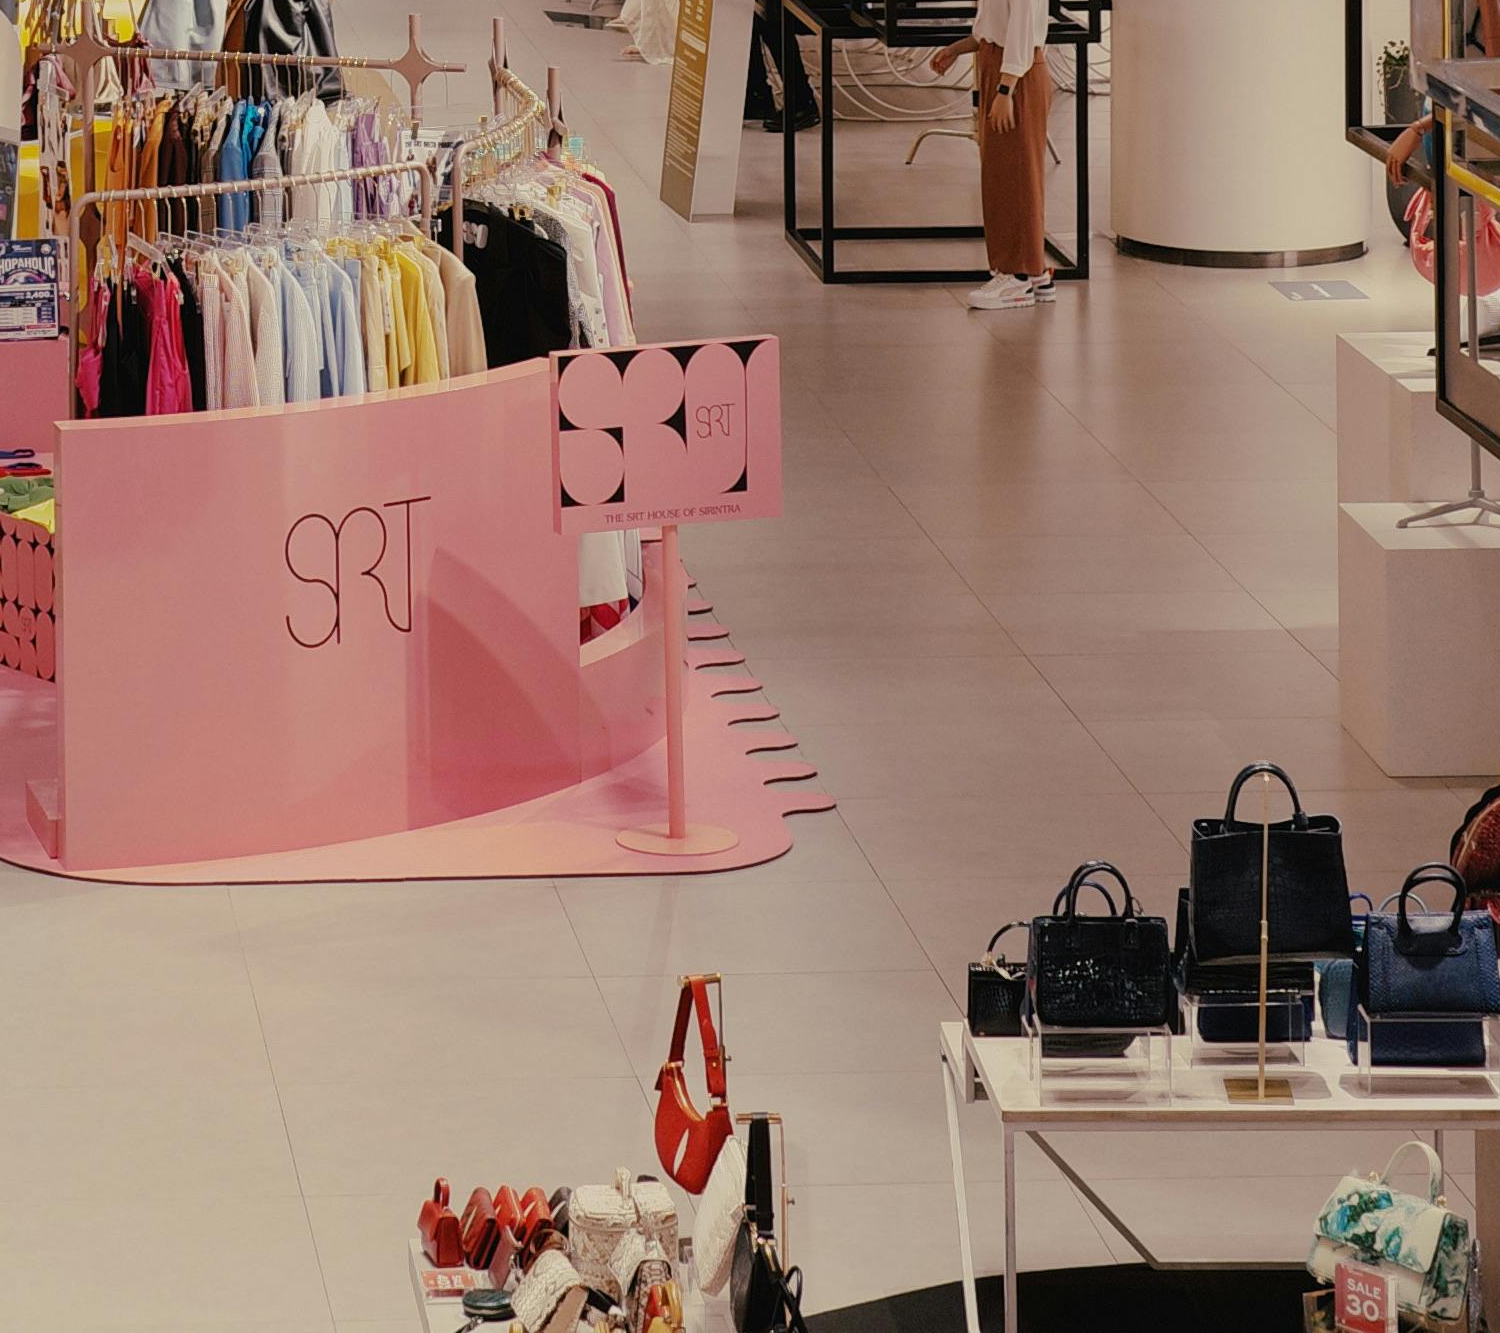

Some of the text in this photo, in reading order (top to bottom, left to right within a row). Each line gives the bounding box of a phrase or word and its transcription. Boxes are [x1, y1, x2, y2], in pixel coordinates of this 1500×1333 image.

[25, 291, 50, 300] 2,400
[696, 403, 736, 439] SRT
[605, 503, 742, 524] THE SRT HOUSE OF SIRINTRA
[285, 495, 432, 649] SRT
[1346, 1277, 1382, 1301] SALE
[1345, 1294, 1380, 1323] 30
